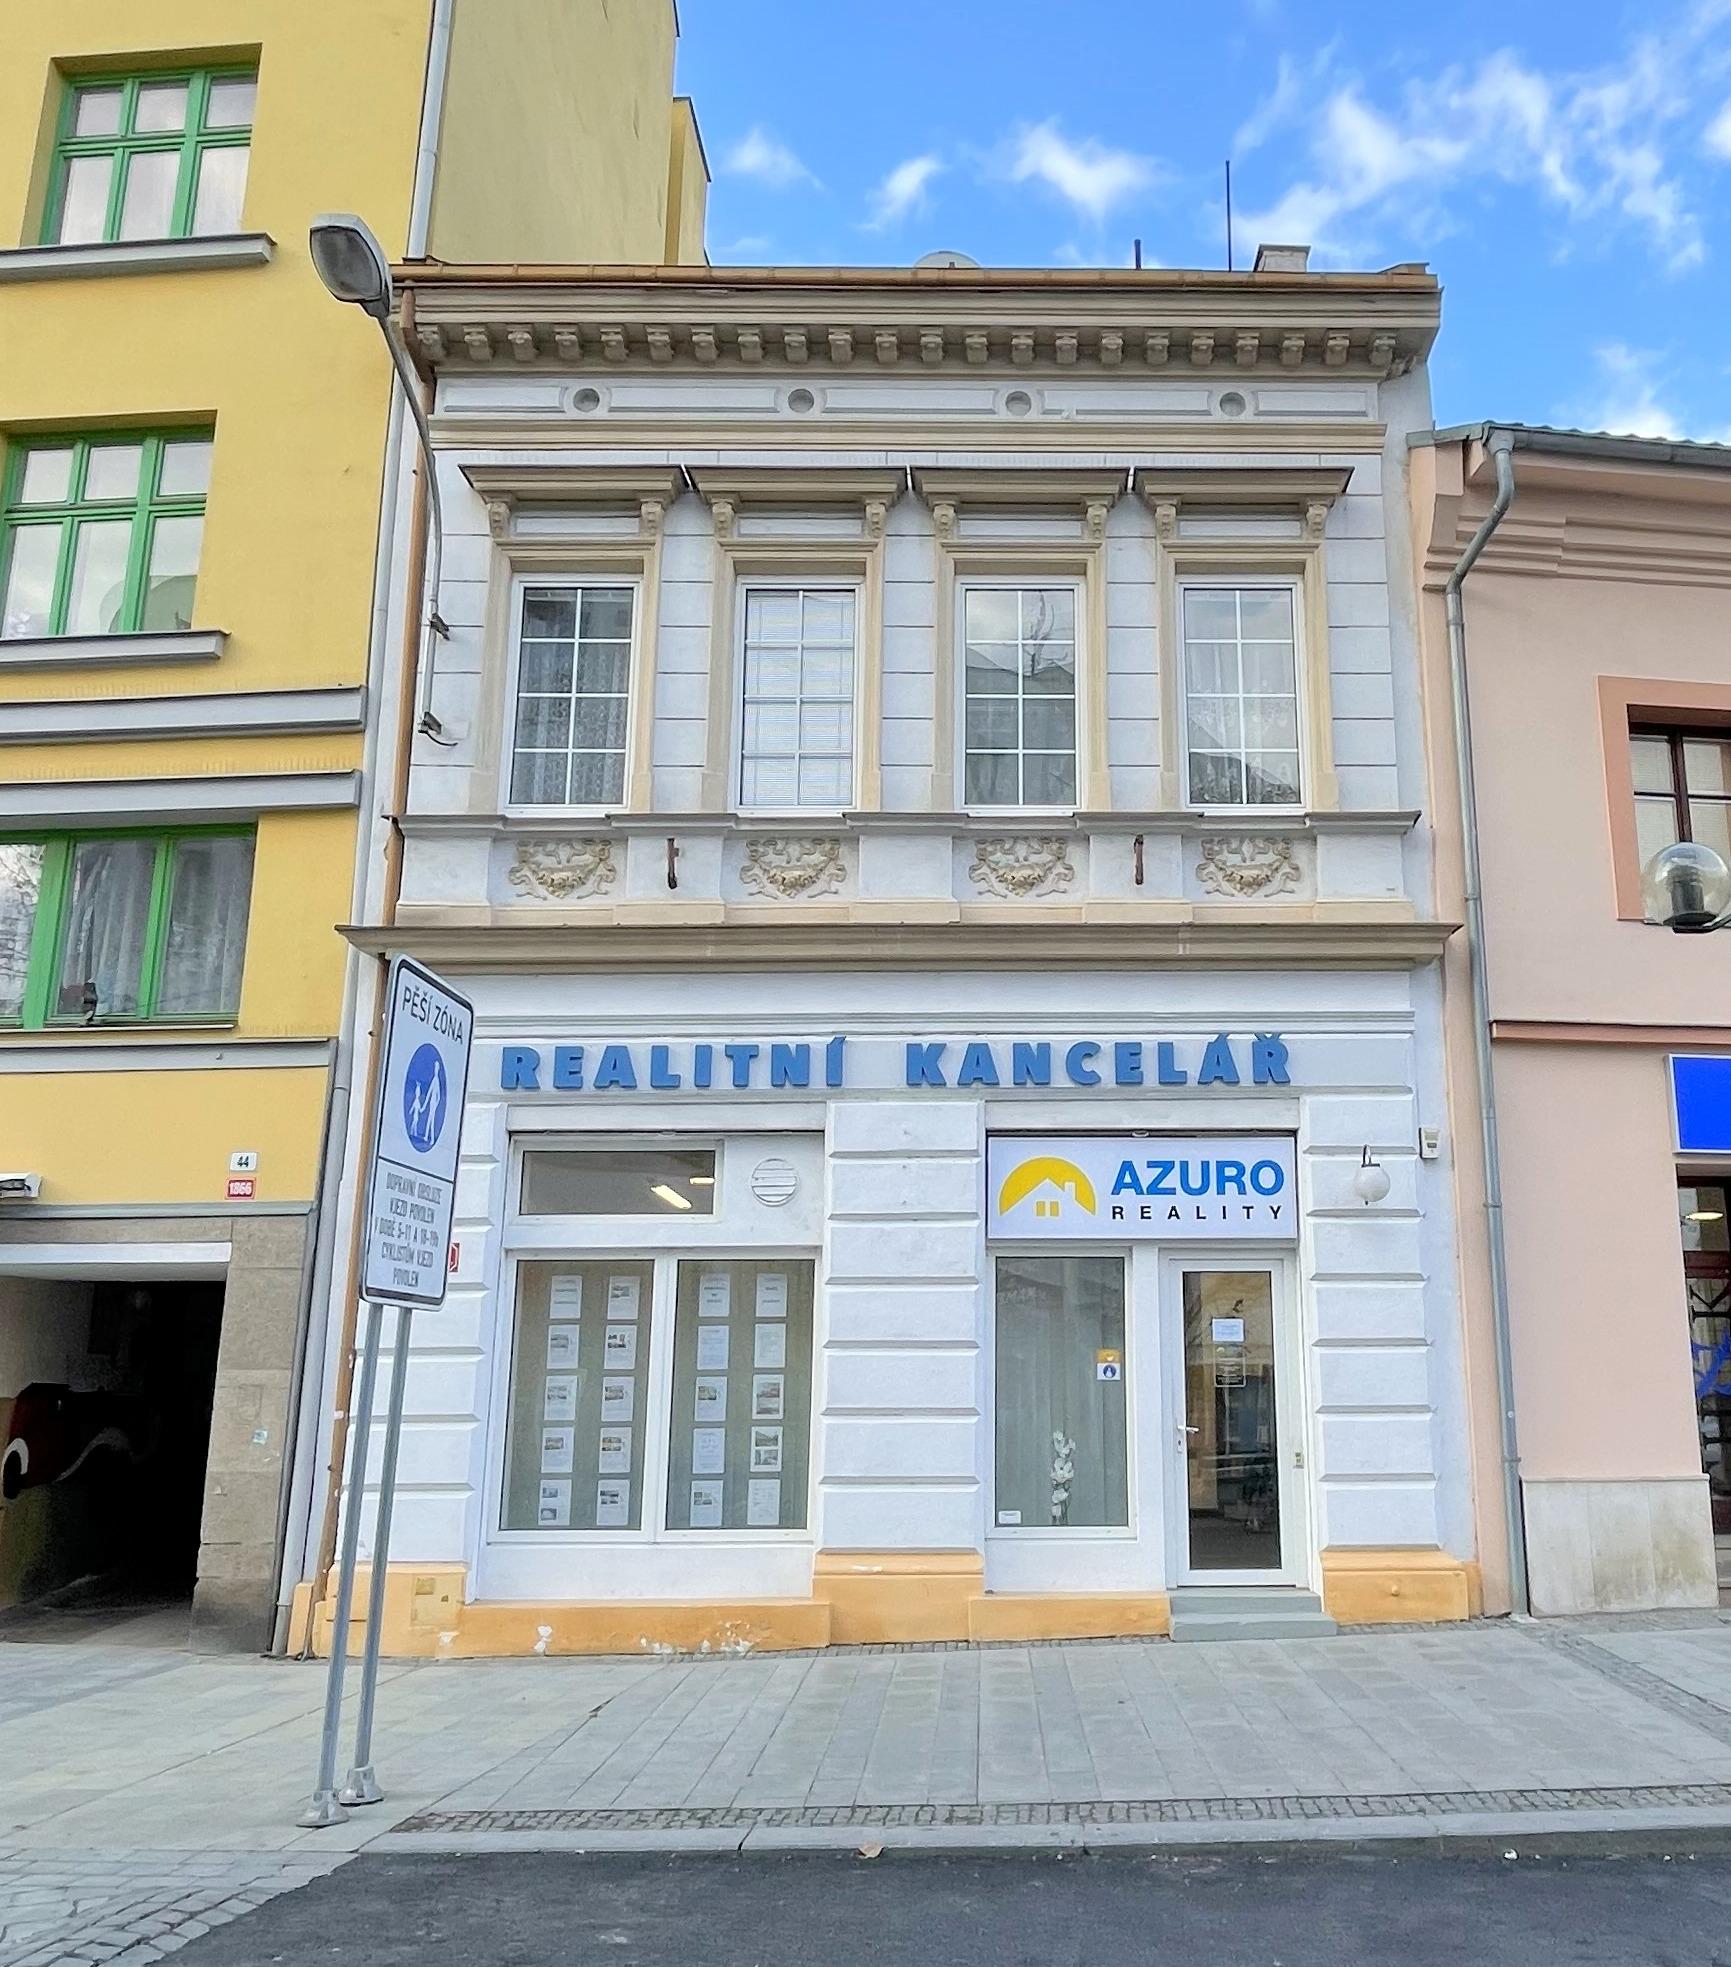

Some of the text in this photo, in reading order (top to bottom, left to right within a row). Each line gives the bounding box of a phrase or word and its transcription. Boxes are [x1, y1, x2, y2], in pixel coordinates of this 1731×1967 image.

[402, 985, 464, 1045] PĚŠÍ ZÓNA
[501, 1032, 1291, 1089] REALITNÍ KANCELÁŘ
[237, 1156, 249, 1167] 44
[1111, 1160, 1284, 1196] AZURO
[1112, 1205, 1283, 1220] REALITY
